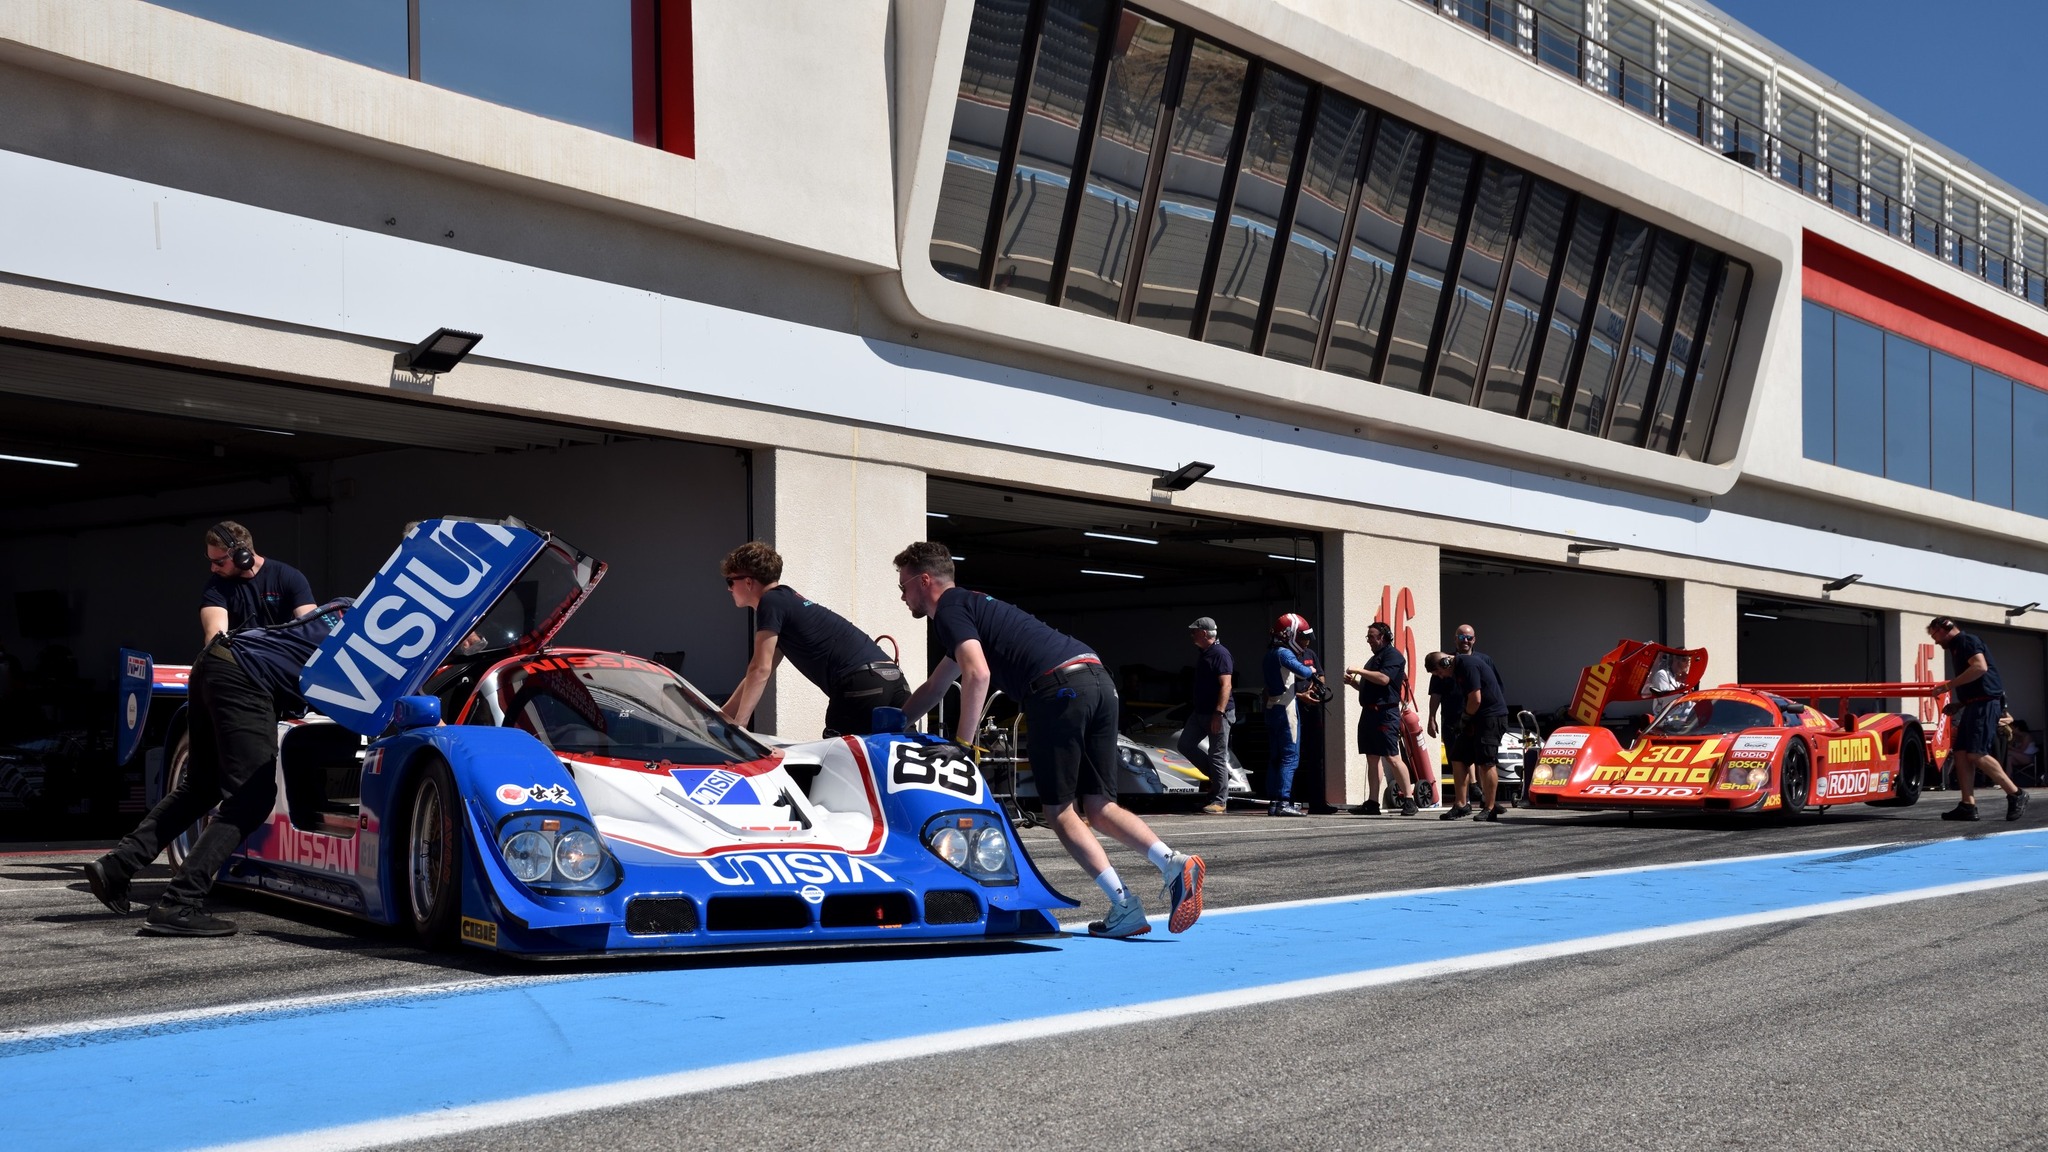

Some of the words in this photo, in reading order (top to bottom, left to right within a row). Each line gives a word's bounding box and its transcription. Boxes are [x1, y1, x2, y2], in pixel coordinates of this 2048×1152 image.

[523, 657, 676, 678] NISSAN
[1915, 644, 1934, 723] 15
[1539, 757, 1574, 765] BOSCH
[1641, 746, 1692, 763] 30
[893, 744, 977, 796] 83
[1728, 761, 1766, 769] BOSCH
[1590, 786, 1693, 796] RODIO
[1720, 782, 1757, 790] Shell
[1829, 772, 1867, 795] RODIO
[278, 821, 356, 876] NISSAN
